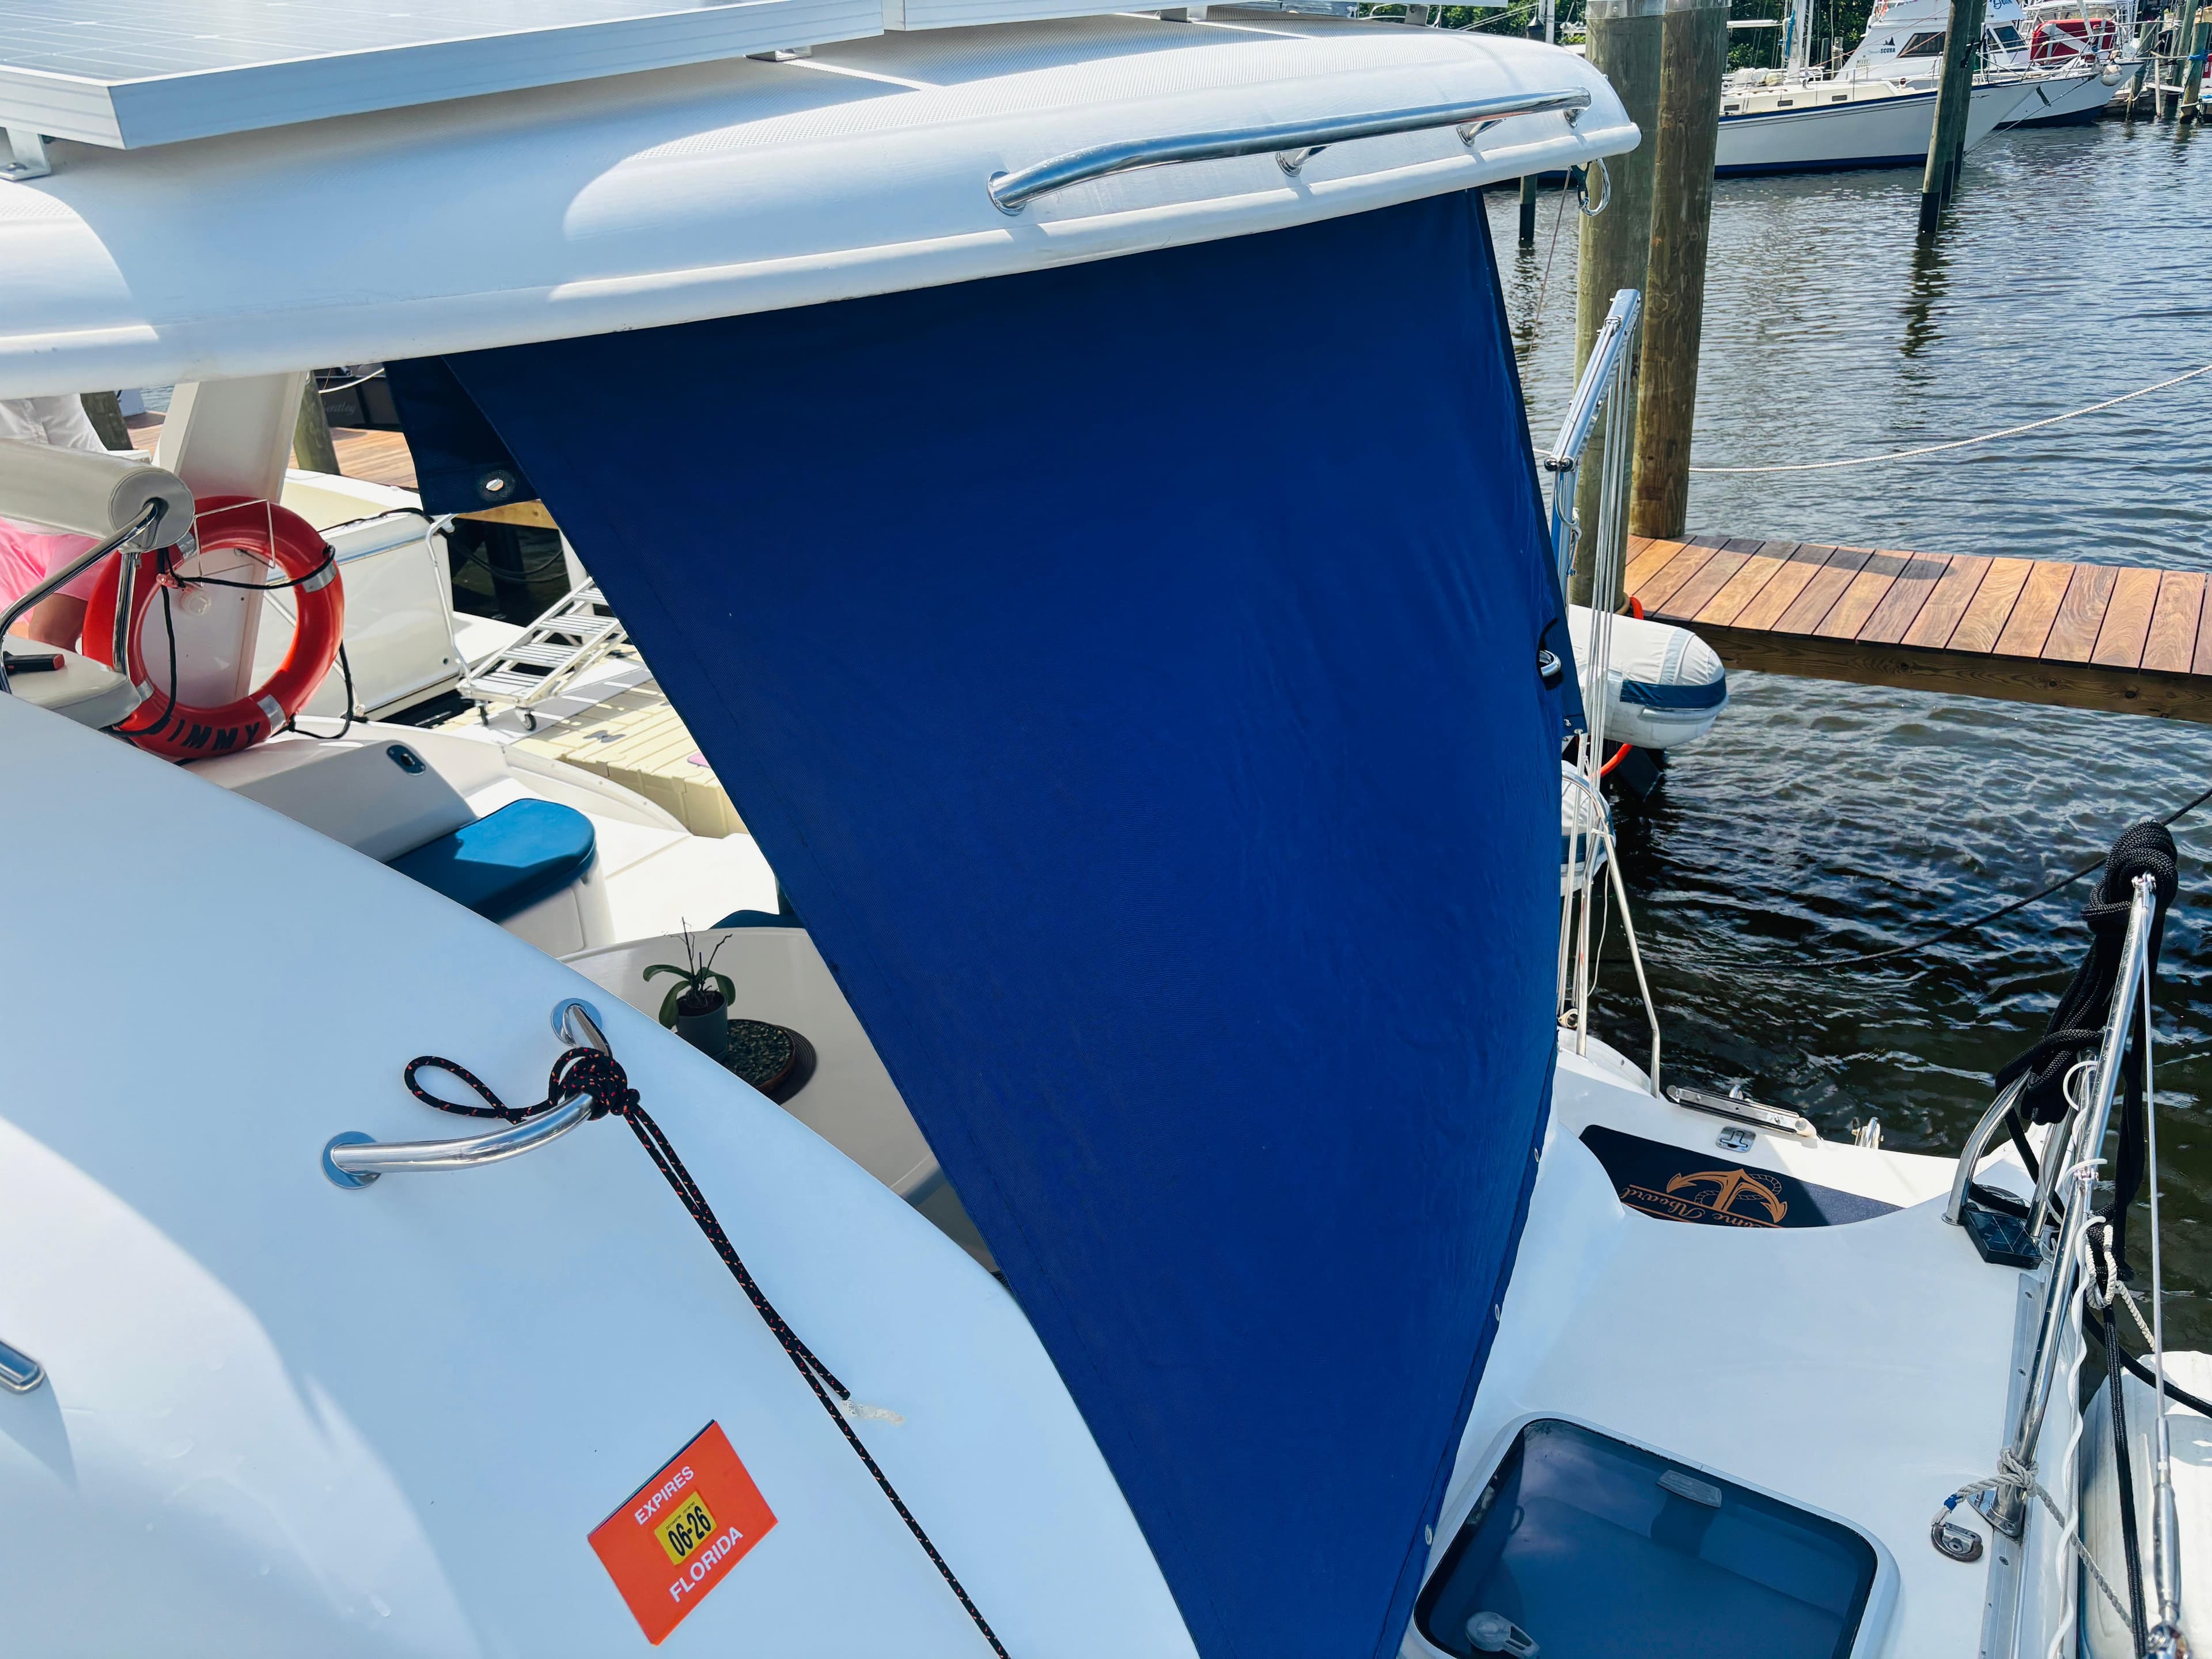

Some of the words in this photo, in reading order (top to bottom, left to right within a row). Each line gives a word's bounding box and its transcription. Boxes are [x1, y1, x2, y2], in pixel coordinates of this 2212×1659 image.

[324, 400, 355, 415] entley
[1619, 1187, 1706, 1218] Aboard
[634, 1465, 694, 1525] EXPIRES
[668, 1505, 711, 1556] 06-26
[669, 1527, 744, 1603] FLORIDA
